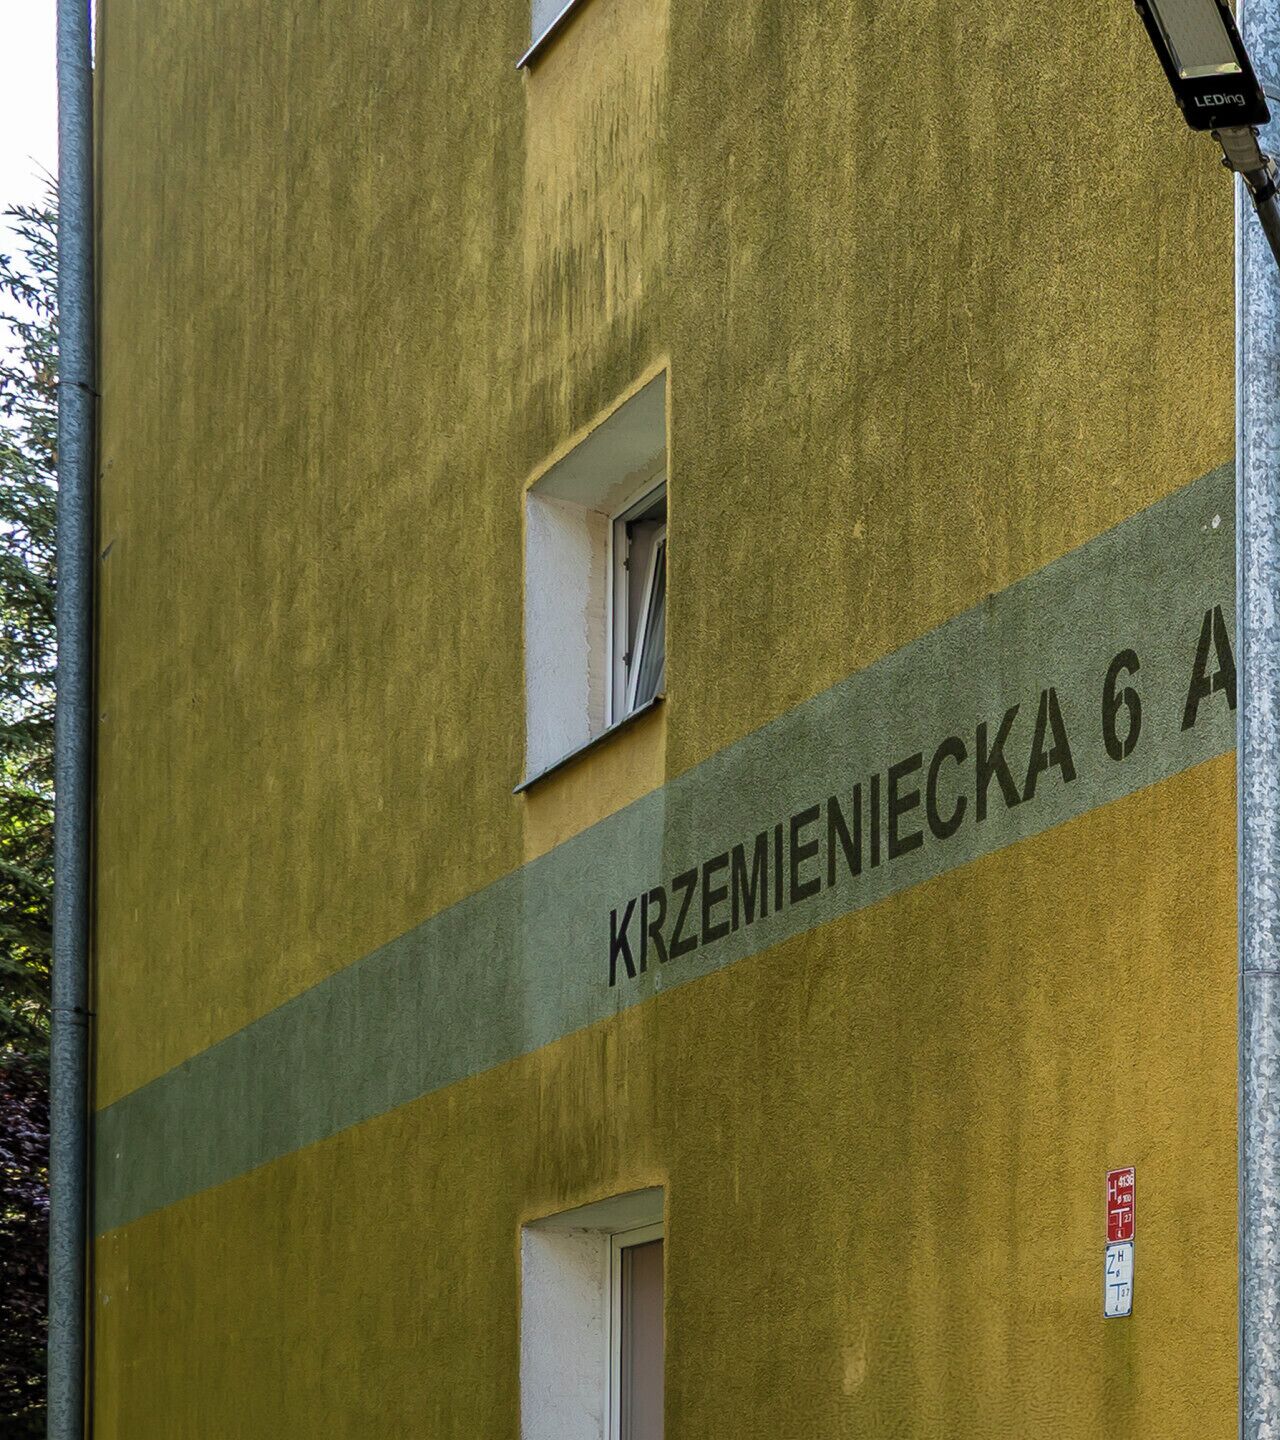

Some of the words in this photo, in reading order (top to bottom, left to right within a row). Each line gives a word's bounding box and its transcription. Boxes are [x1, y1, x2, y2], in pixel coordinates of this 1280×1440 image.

[1194, 93, 1246, 107] LEDing
[608, 687, 1077, 988] KRZEMIENIECKA
[1102, 648, 1143, 761] 6
[1180, 604, 1238, 732] A
[1108, 1180, 1118, 1201] H
[1107, 1254, 1115, 1274] Z
